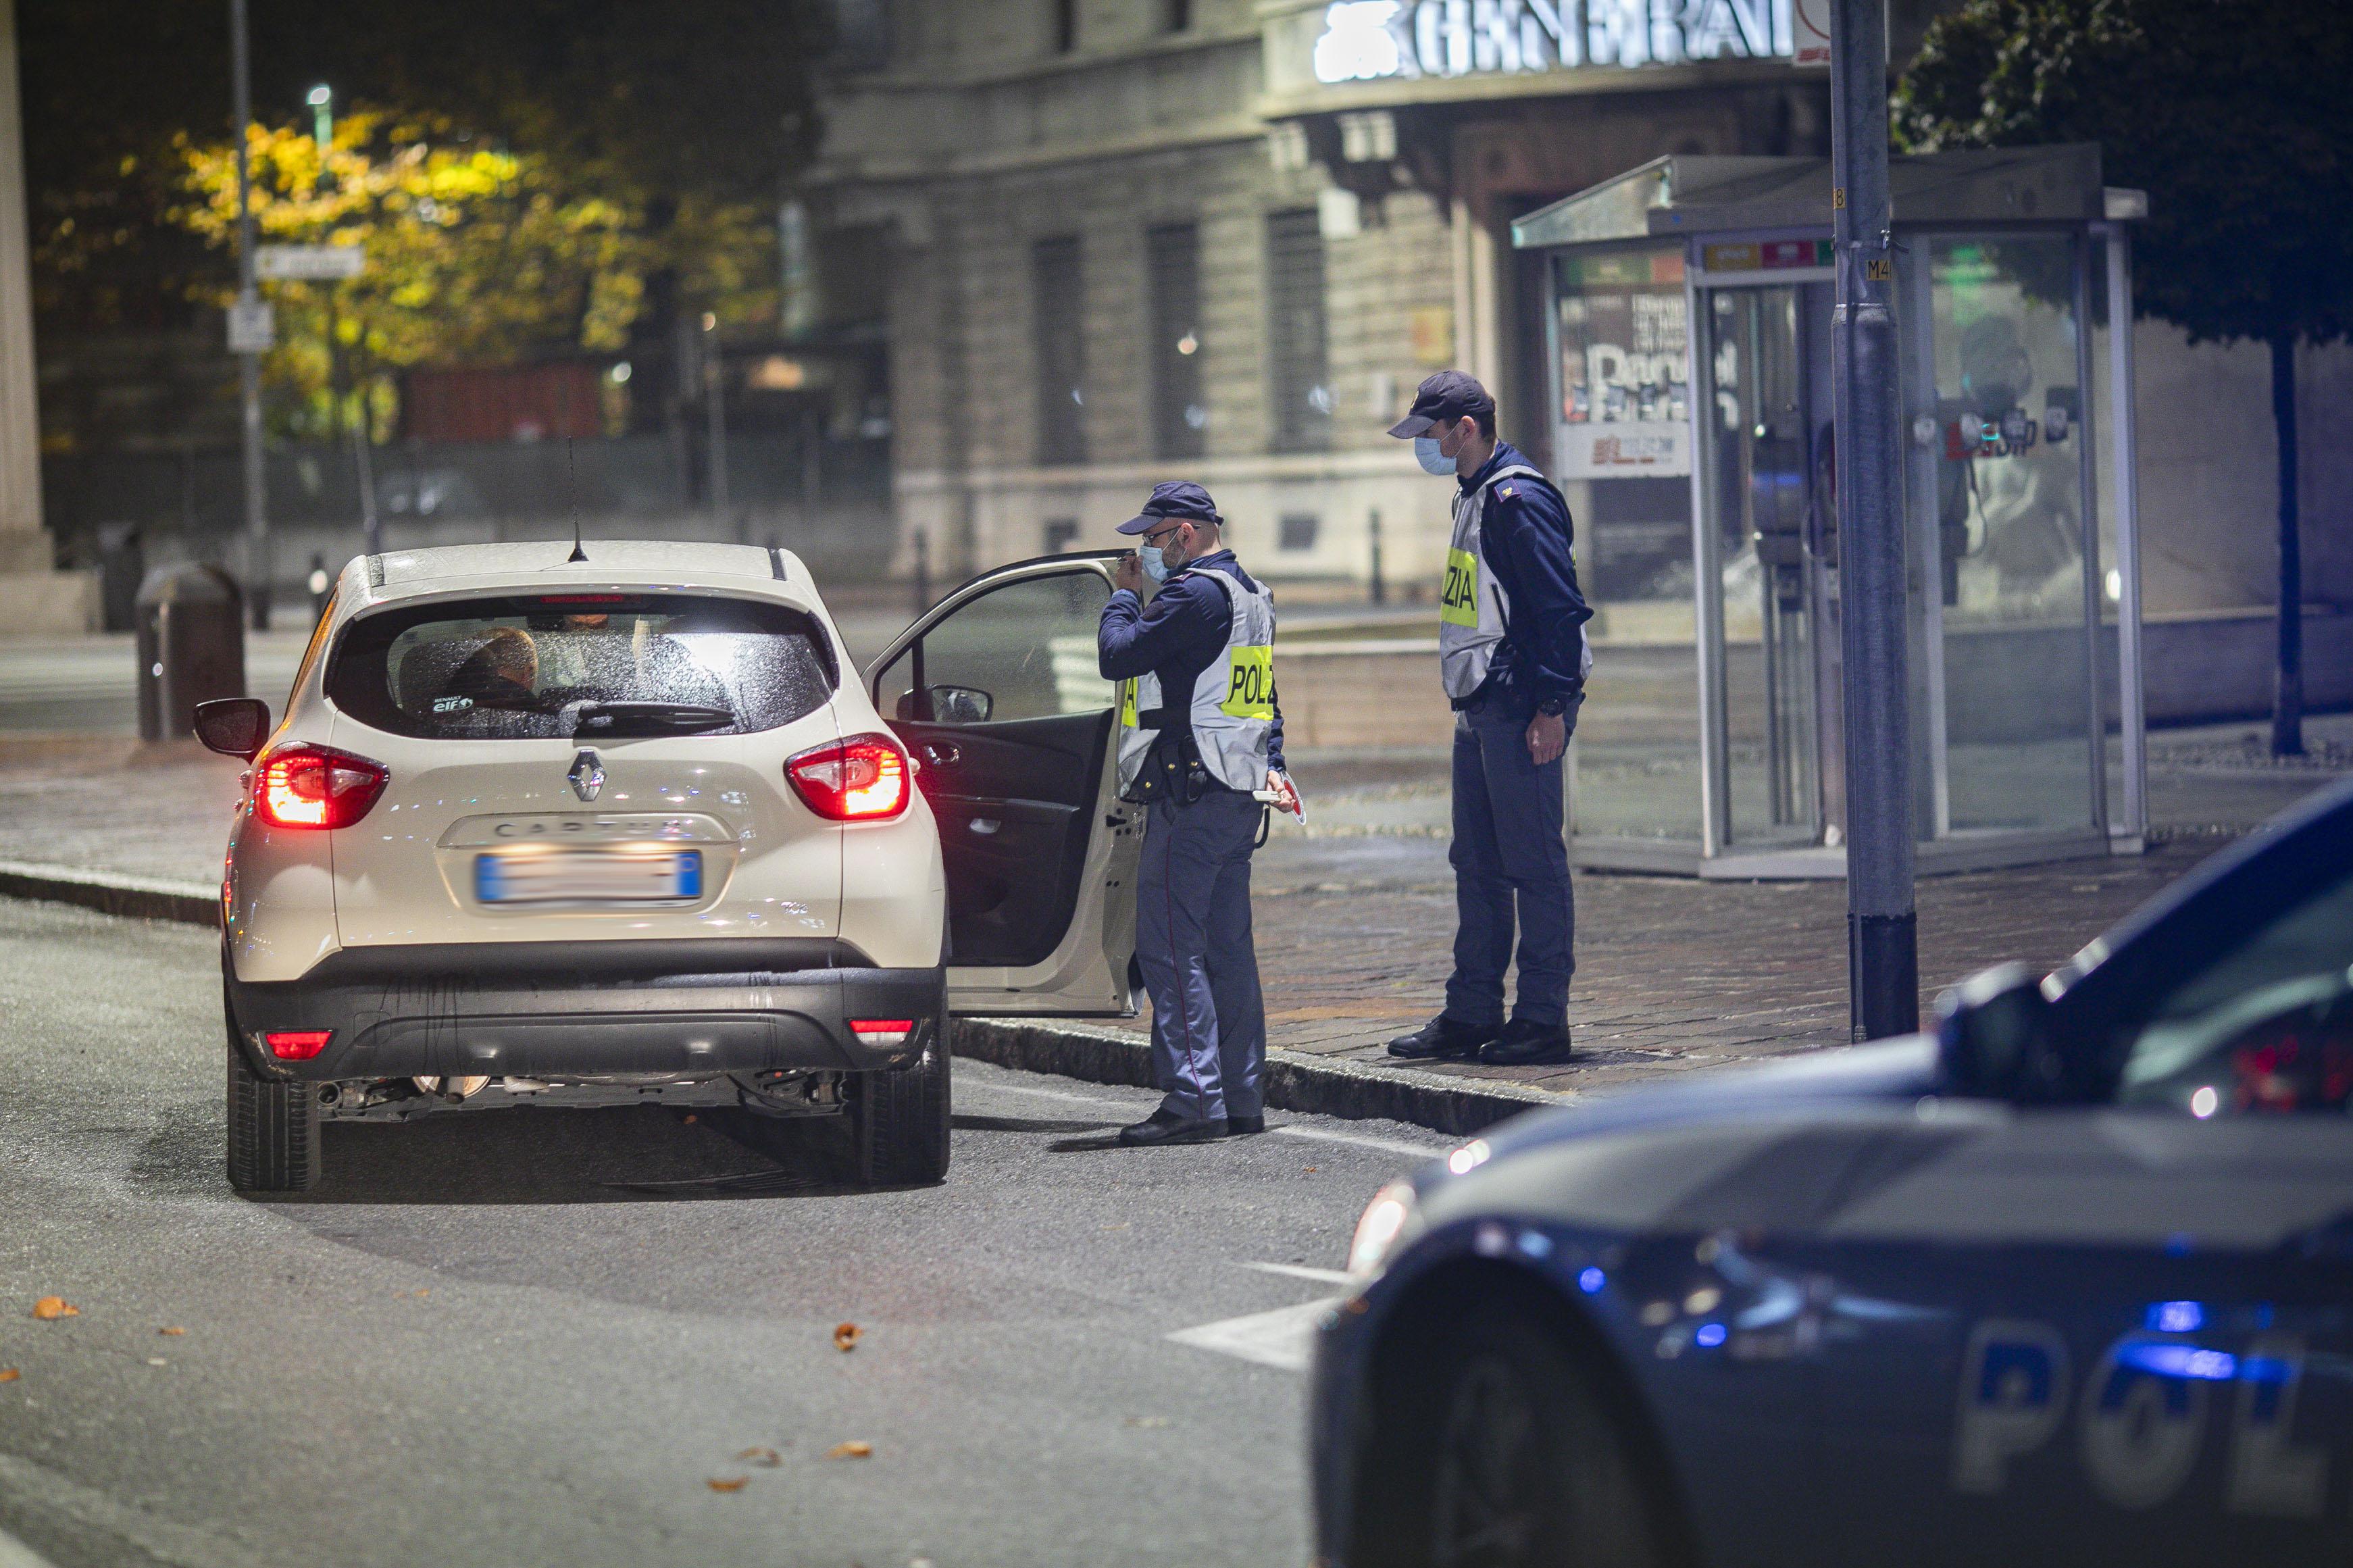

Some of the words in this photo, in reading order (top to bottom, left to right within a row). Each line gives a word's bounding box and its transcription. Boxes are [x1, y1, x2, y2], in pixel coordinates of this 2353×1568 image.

[1868, 260, 1892, 279] M4
[434, 695, 462, 703] RENAULT
[433, 700, 459, 712] elf
